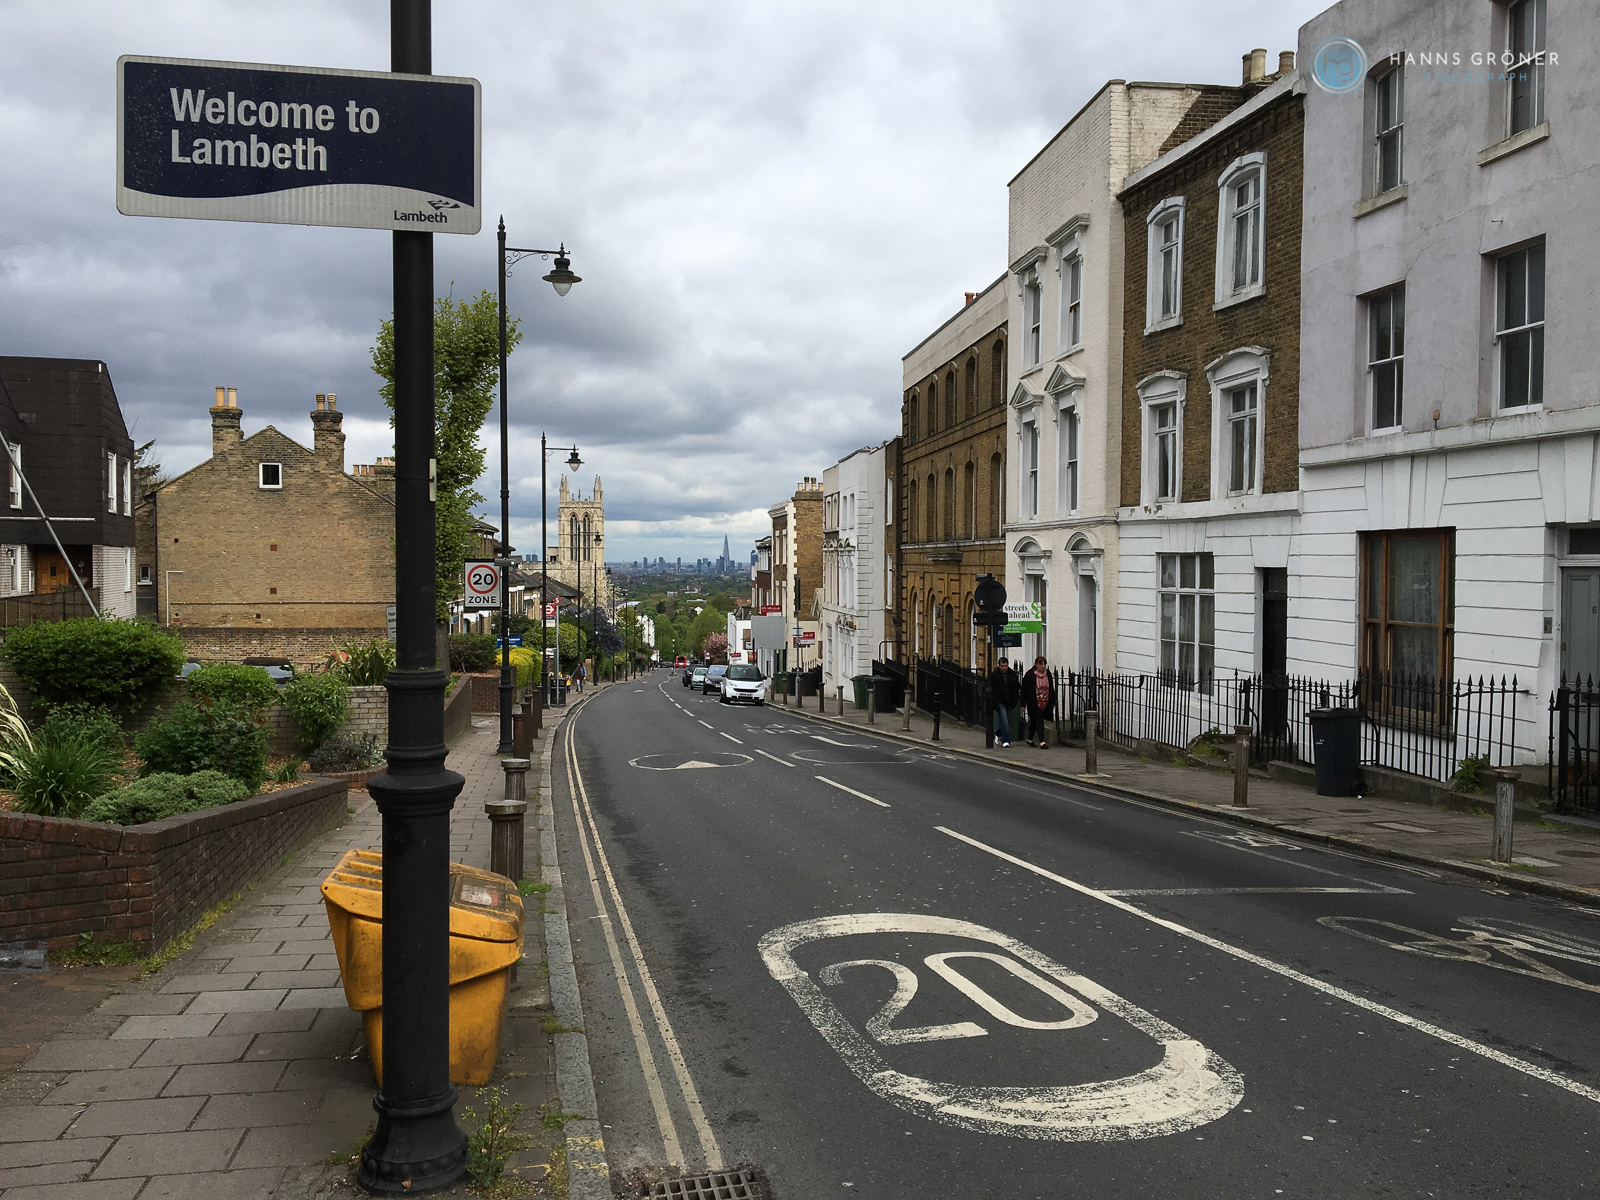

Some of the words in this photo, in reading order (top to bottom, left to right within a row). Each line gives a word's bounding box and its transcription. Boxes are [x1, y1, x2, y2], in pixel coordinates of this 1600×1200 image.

[170, 87, 335, 132] Welcome
[346, 100, 380, 134] to
[171, 129, 328, 172] Lambeth
[394, 210, 448, 224] Lambeth
[472, 573, 494, 586] 20
[468, 596, 497, 604] ZONE
[1592, 606, 1597, 615] 6
[818, 951, 1100, 1046] 20
